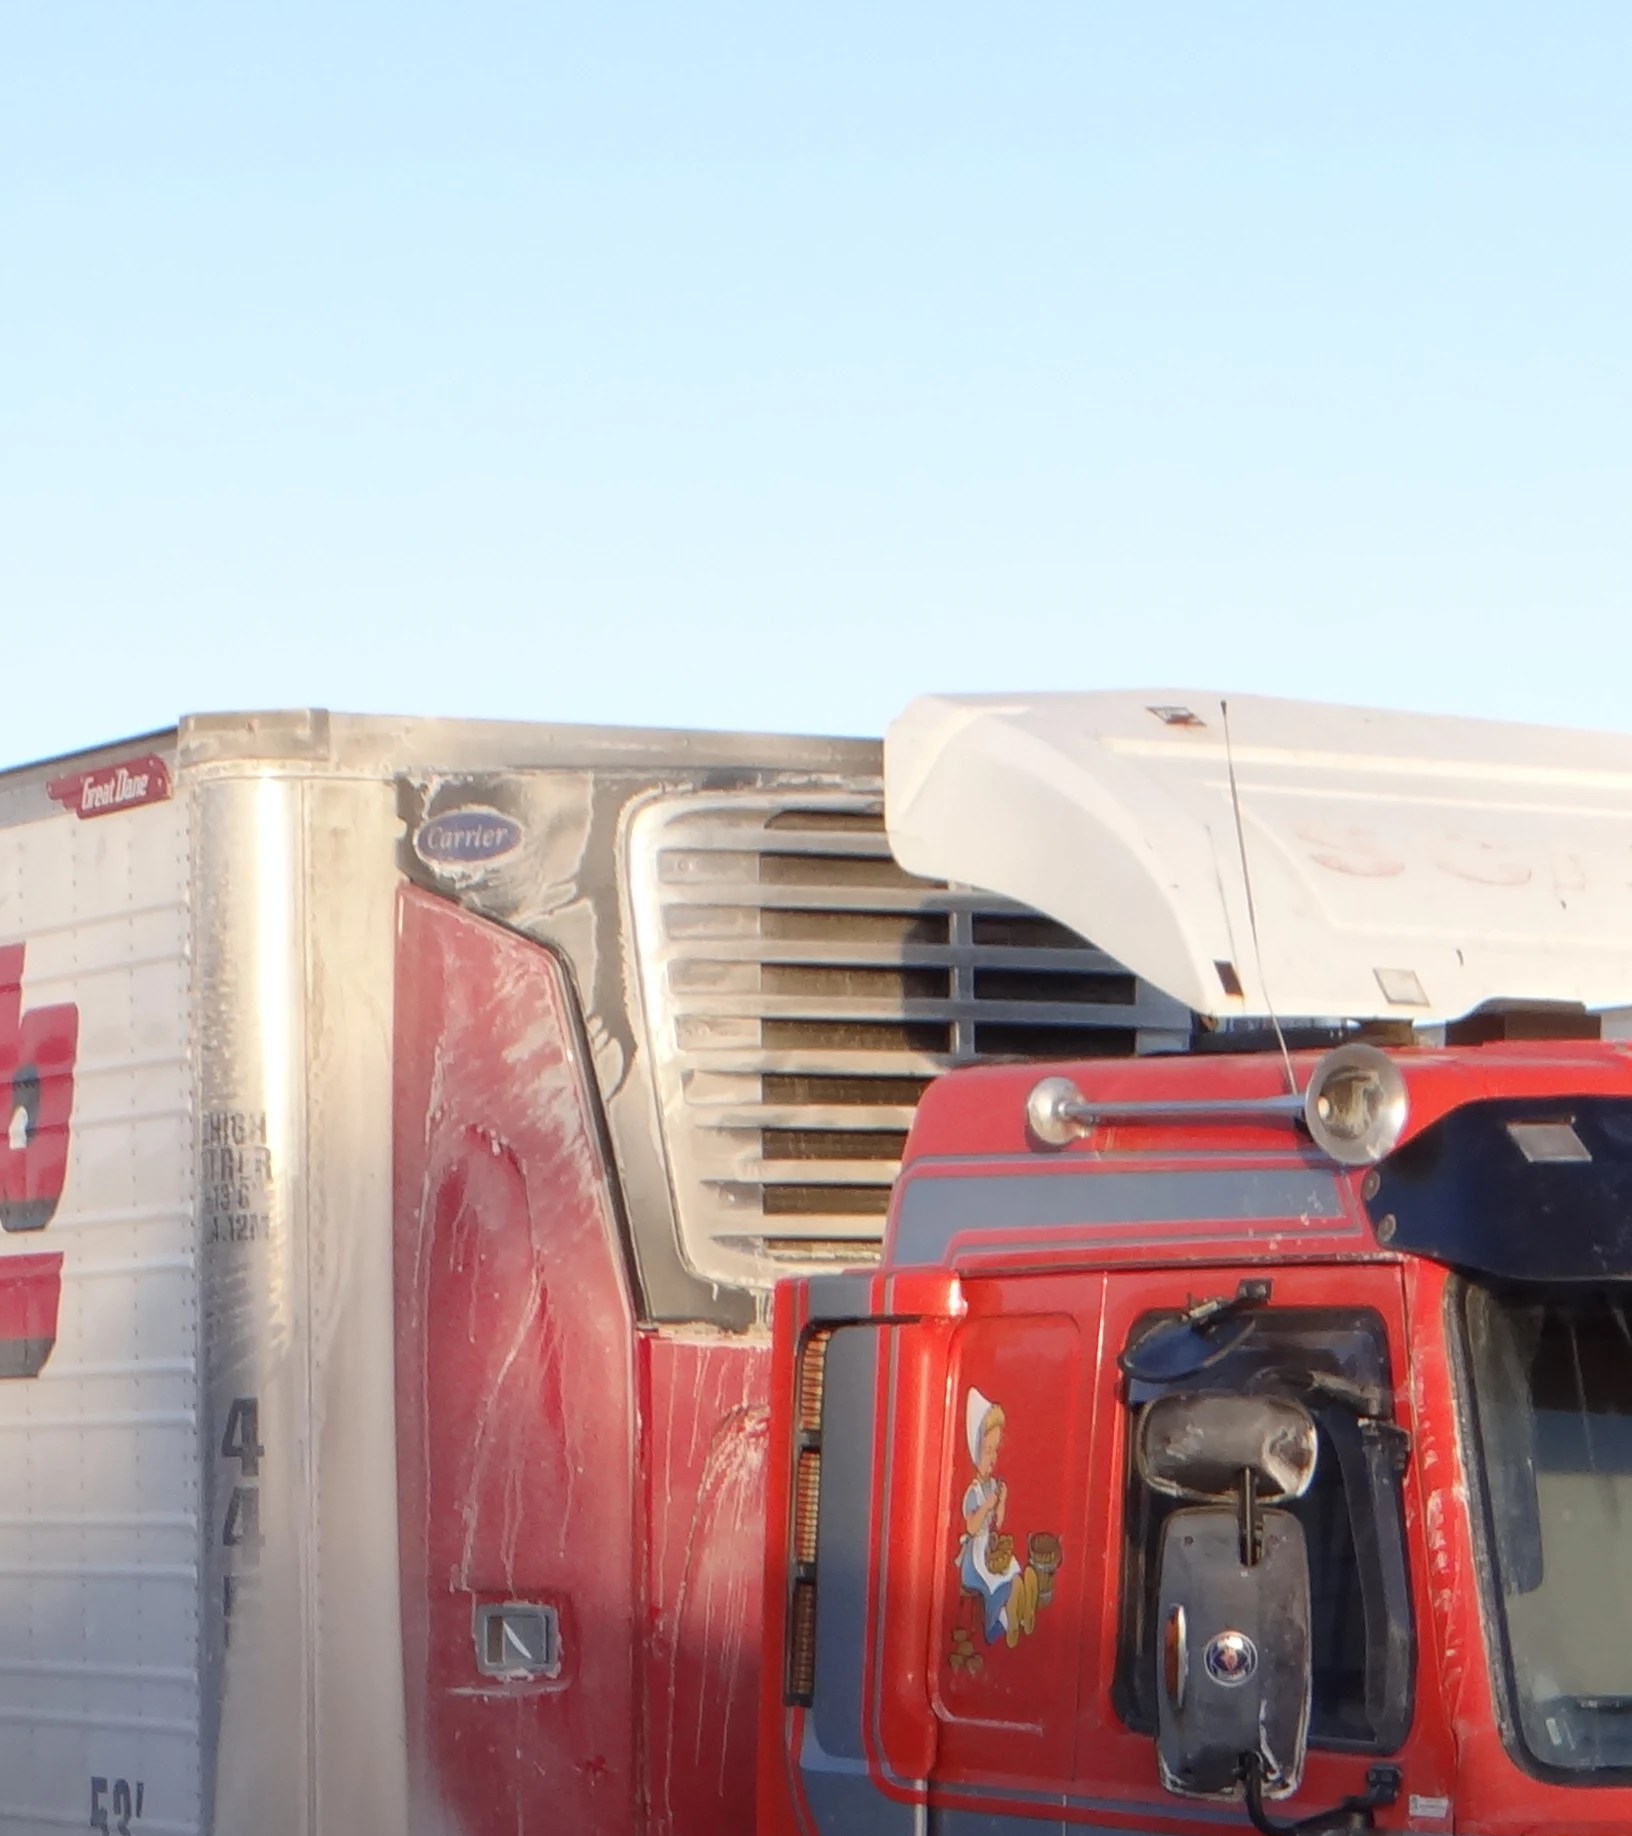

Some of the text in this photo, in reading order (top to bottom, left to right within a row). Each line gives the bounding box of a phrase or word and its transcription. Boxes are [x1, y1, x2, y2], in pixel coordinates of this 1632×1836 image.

[81, 768, 150, 810] Great Dane
[427, 824, 509, 850] Carrier
